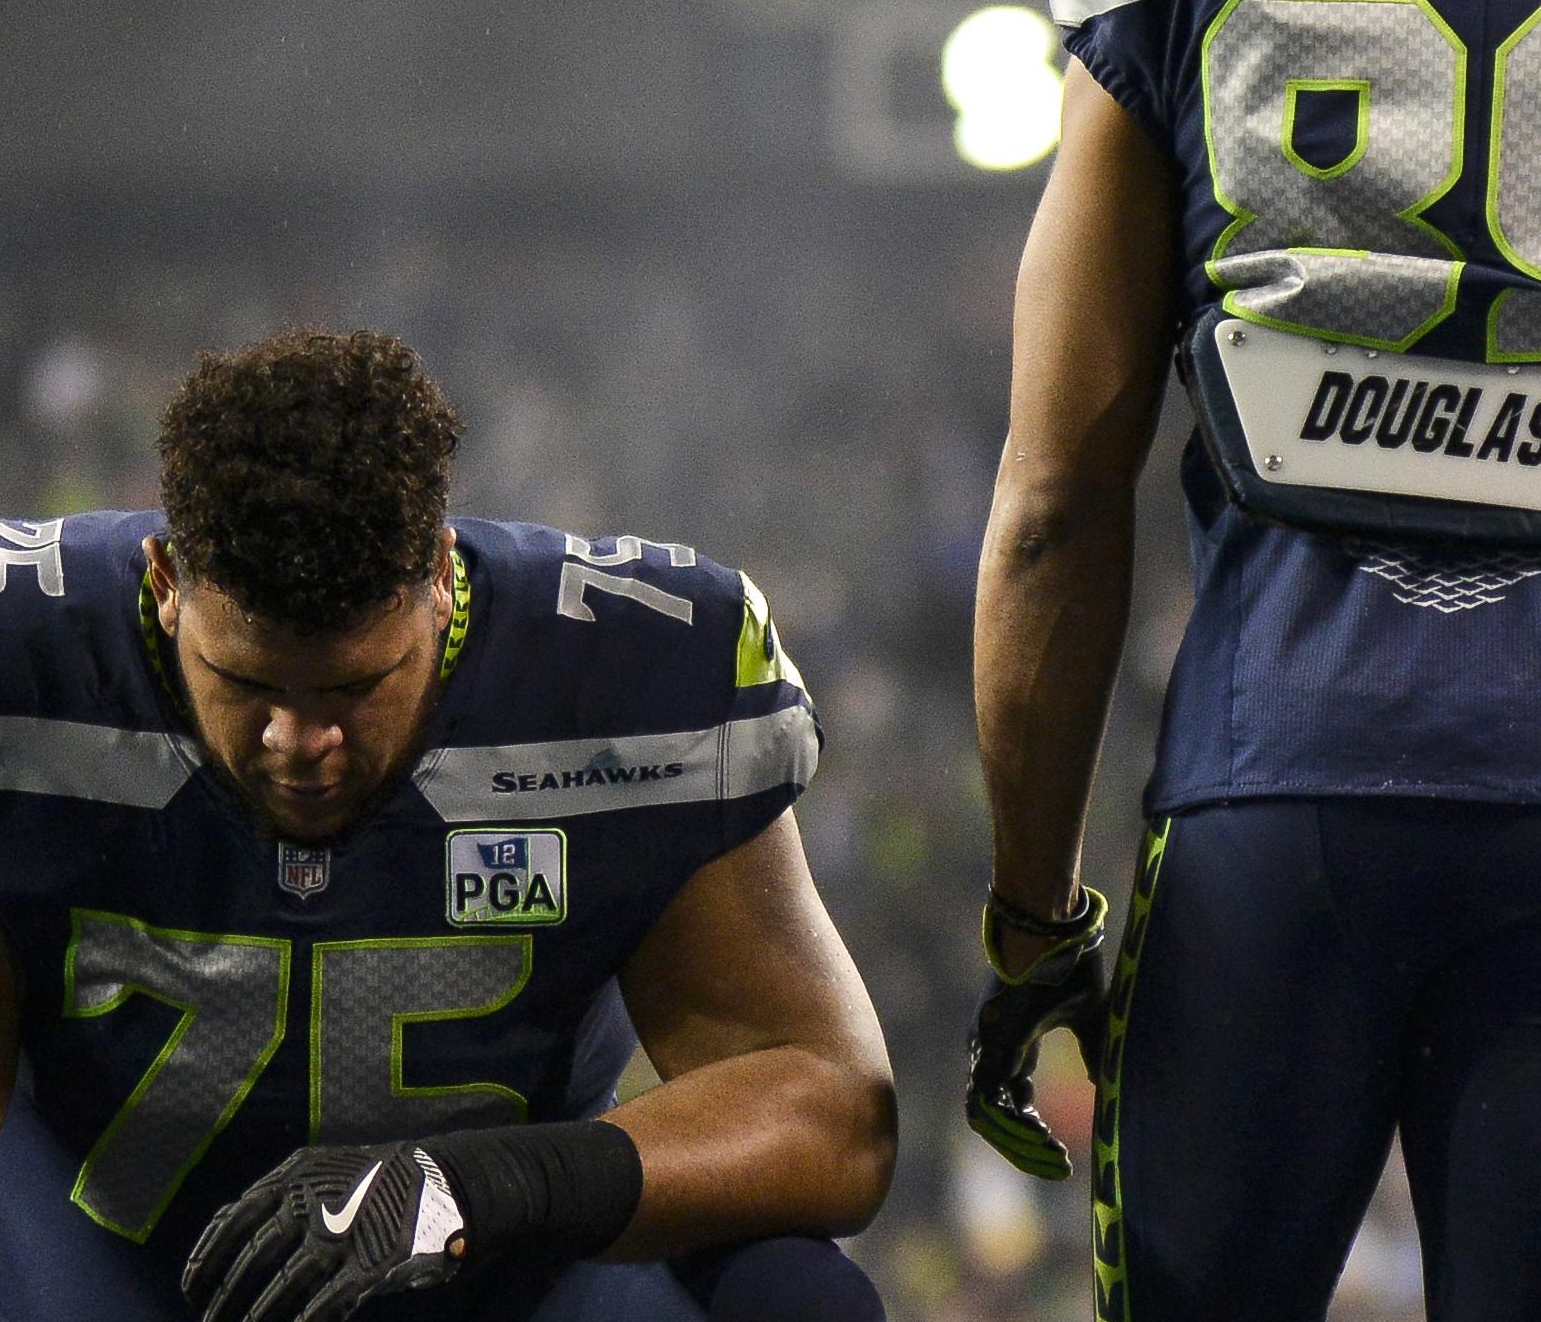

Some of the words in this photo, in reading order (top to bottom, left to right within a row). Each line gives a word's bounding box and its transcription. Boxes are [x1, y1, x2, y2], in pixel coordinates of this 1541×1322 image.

[556, 532, 697, 627] 75
[491, 843, 516, 865] 12
[455, 872, 559, 912] PGA
[65, 908, 534, 1244] 75
